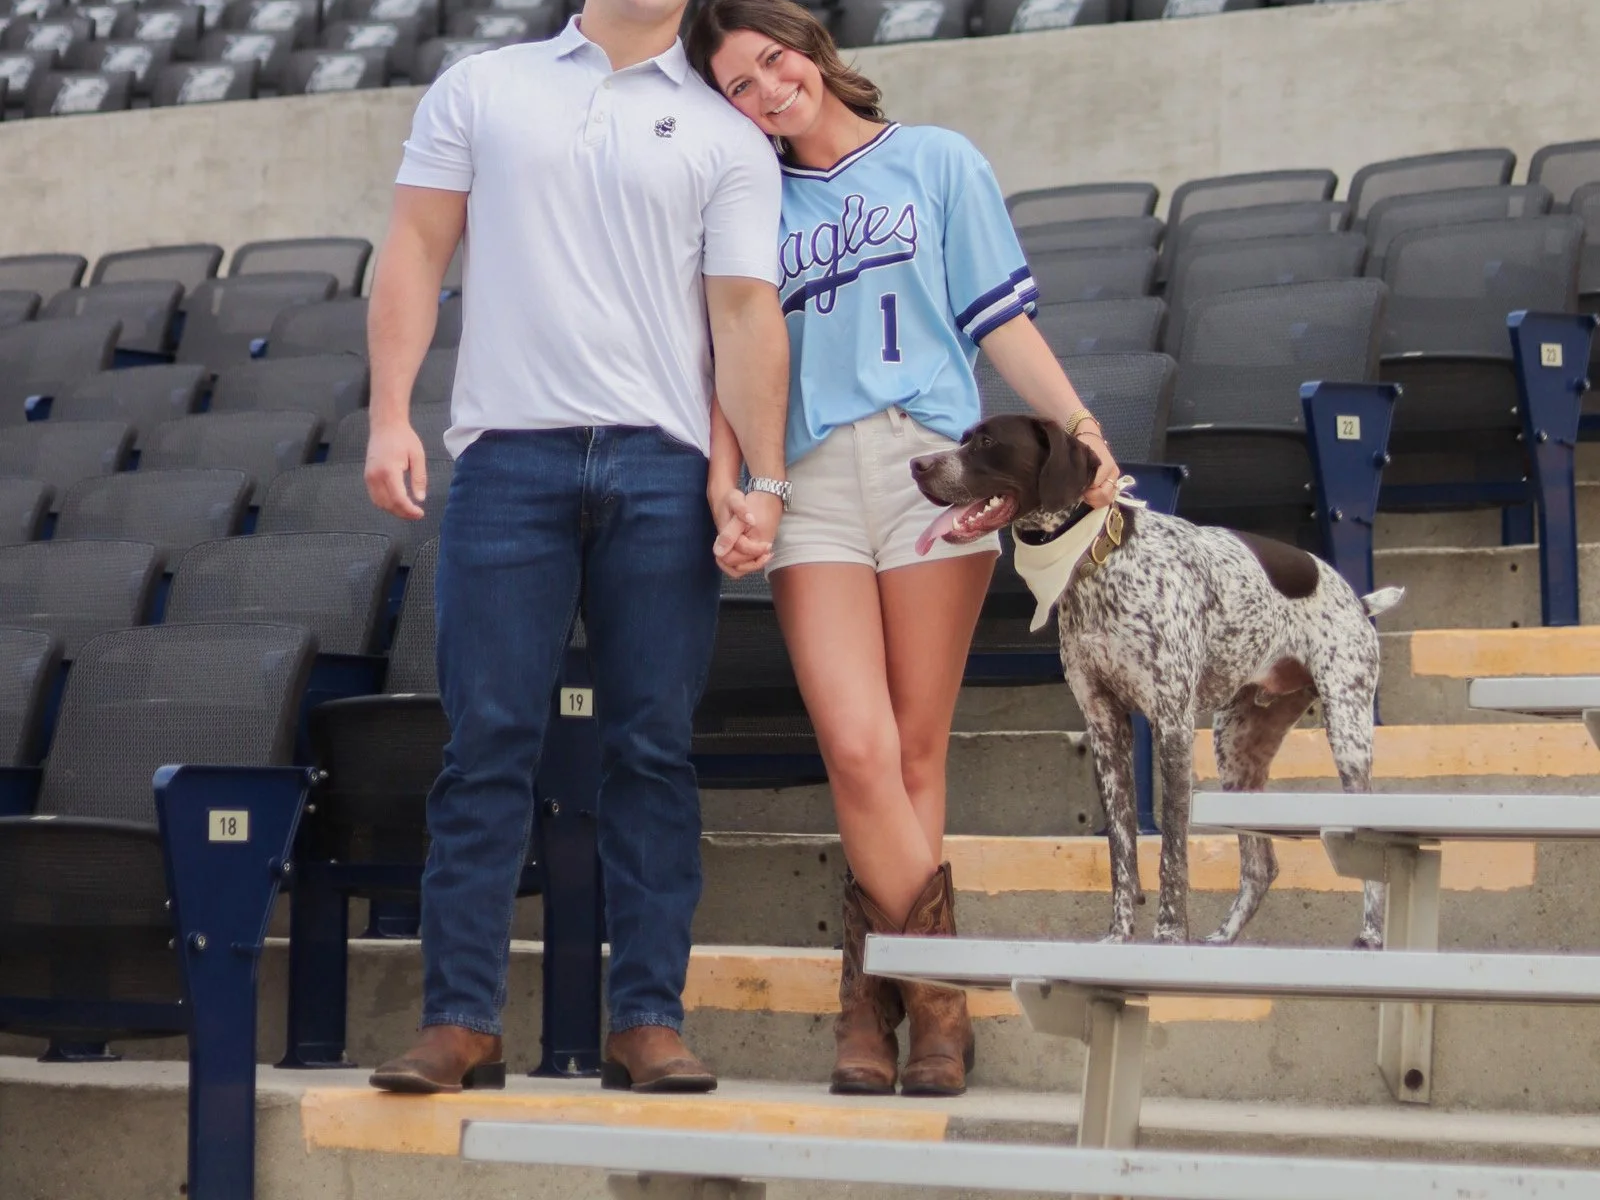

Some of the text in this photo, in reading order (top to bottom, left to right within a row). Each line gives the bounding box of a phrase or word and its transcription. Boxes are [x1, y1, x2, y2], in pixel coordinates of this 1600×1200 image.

[778, 193, 917, 314] agles
[879, 292, 902, 363] 1
[1342, 419, 1354, 436] 22
[569, 693, 584, 712] 19
[219, 816, 238, 836] 18
